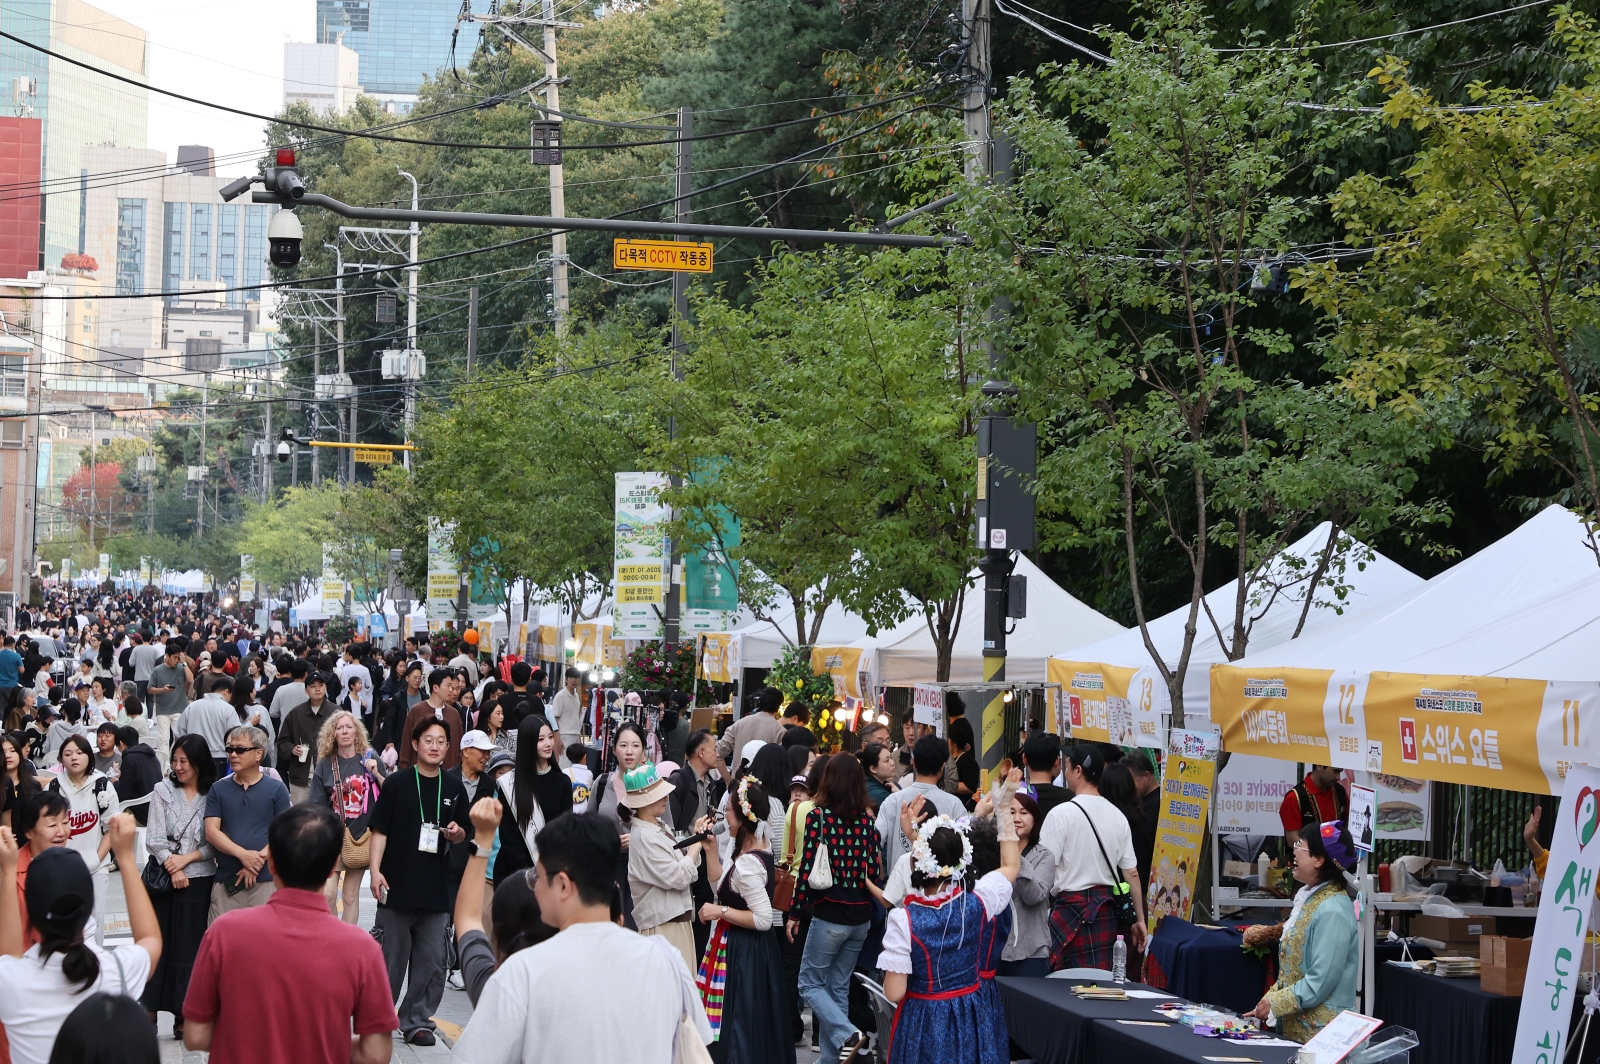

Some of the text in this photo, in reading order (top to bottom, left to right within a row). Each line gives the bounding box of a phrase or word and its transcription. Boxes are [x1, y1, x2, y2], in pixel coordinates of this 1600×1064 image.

[620, 248, 708, 266] 다목적 CCTV 작동중
[1140, 678, 1152, 712] 13
[1339, 684, 1355, 724] 12
[1415, 698, 1426, 710] 제4회
[1427, 699, 1443, 710] 유네스코
[1473, 702, 1482, 714] 축제
[984, 719, 996, 732] CCTV
[1562, 700, 1580, 746] 11
[1422, 724, 1503, 770] 스위스 요들
[1165, 779, 1182, 795] 3대가
[1183, 781, 1210, 800] 함께하는
[1169, 800, 1201, 819] 동요한마당
